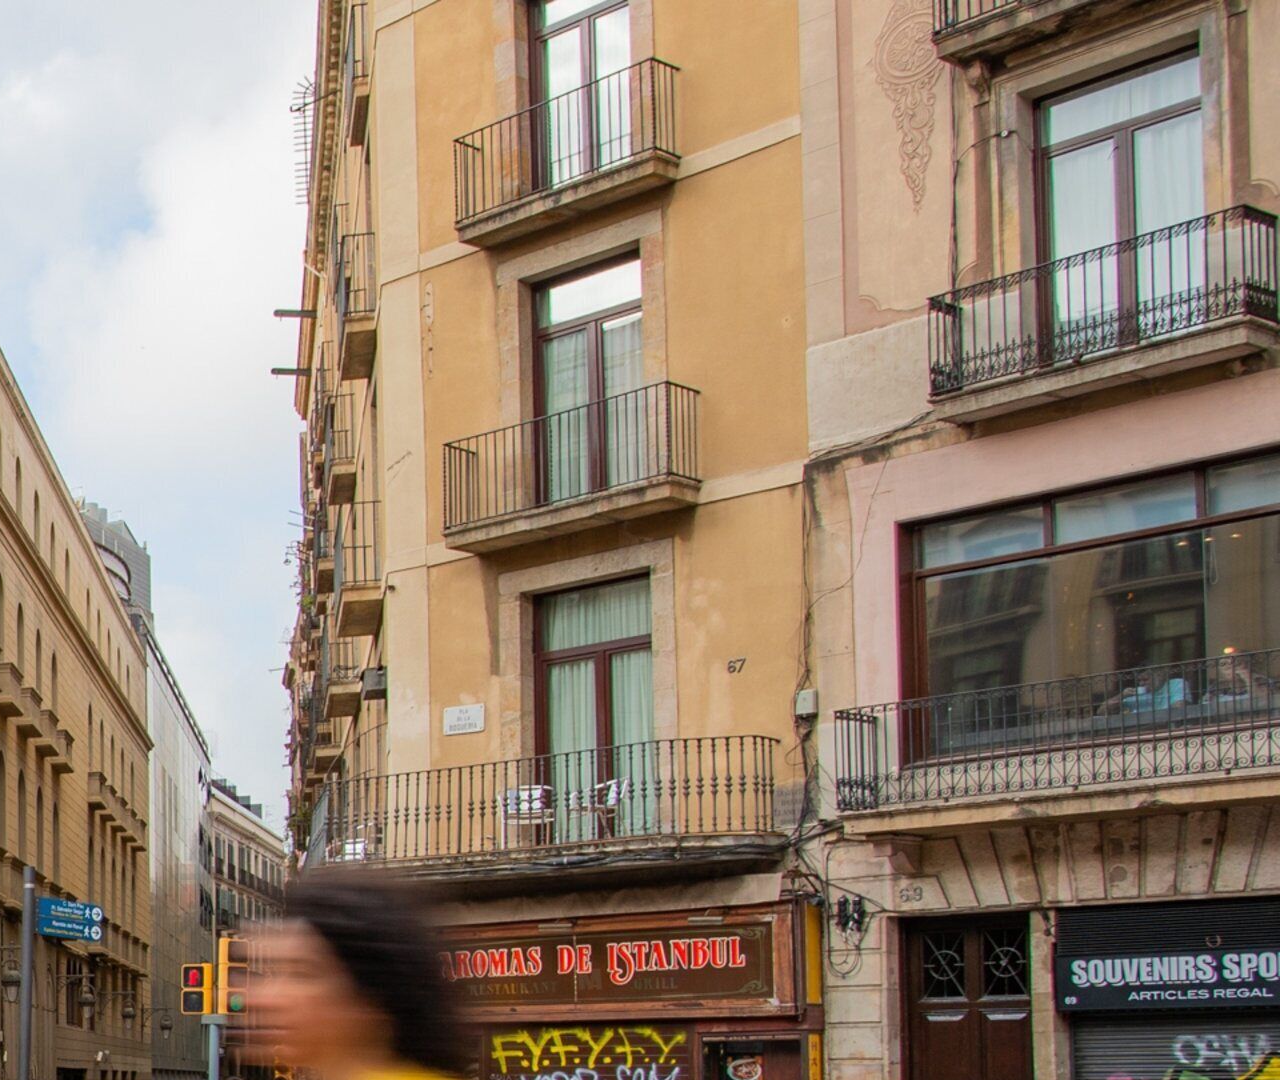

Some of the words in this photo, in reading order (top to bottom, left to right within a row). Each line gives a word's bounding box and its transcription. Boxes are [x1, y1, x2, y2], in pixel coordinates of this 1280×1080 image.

[727, 658, 746, 674] 67
[899, 886, 923, 903] 69
[442, 946, 542, 981] AROMAS
[557, 944, 593, 975] DE
[606, 936, 746, 986] ISTANBUL
[1071, 953, 1218, 988] SOUVENIRS
[1222, 951, 1280, 983] SPO
[1128, 988, 1210, 1001] ARTICLES
[1213, 987, 1274, 999] REGAL
